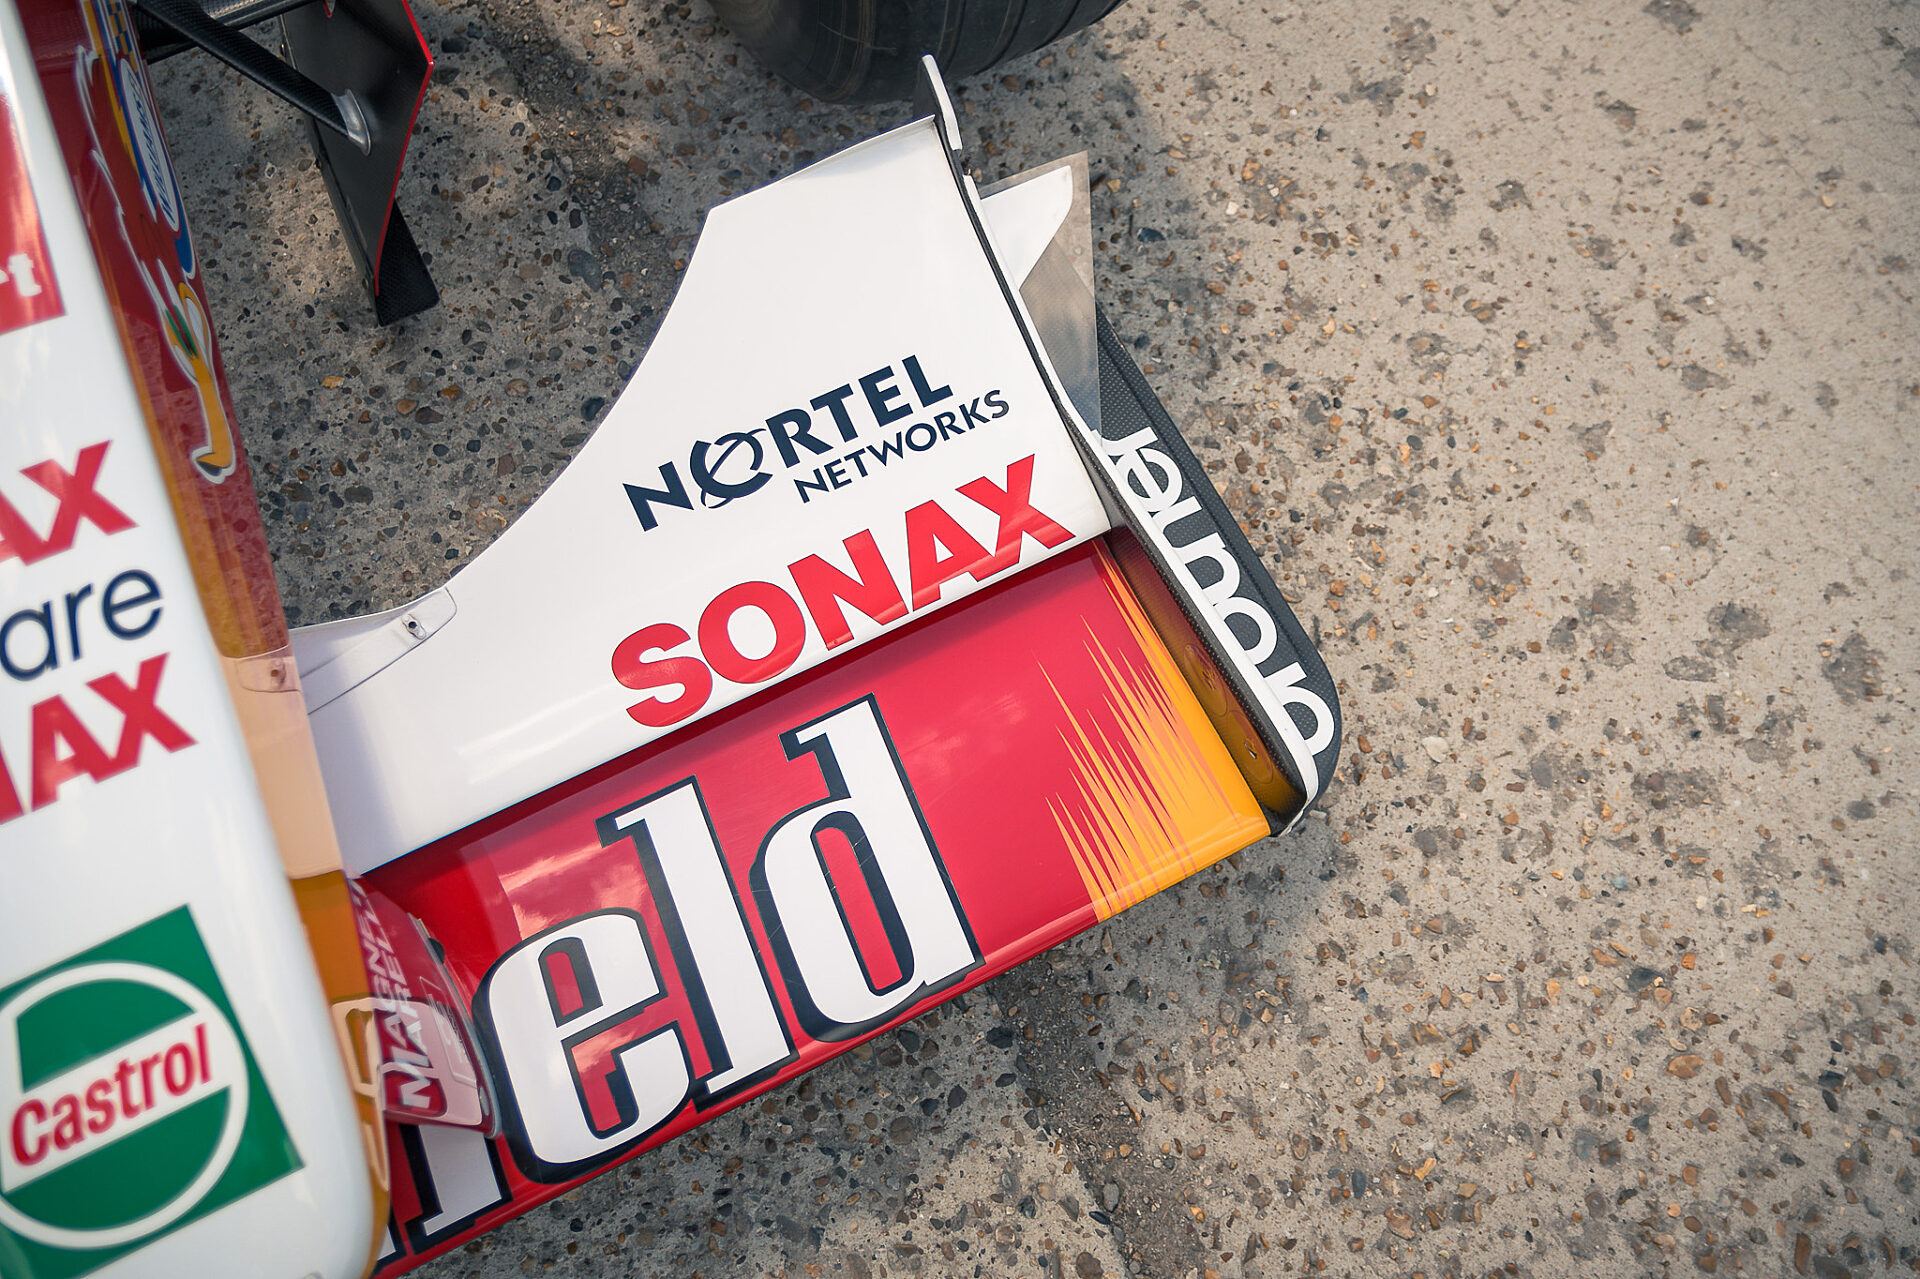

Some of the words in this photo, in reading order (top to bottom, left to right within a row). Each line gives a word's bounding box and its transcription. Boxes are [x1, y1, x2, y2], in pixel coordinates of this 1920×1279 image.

[623, 354, 954, 532] NORTEL
[793, 389, 1010, 503] NETWORKS
[0, 569, 164, 682] are
[611, 454, 1076, 728] SONAX
[10, 1021, 212, 1167] Castrol
